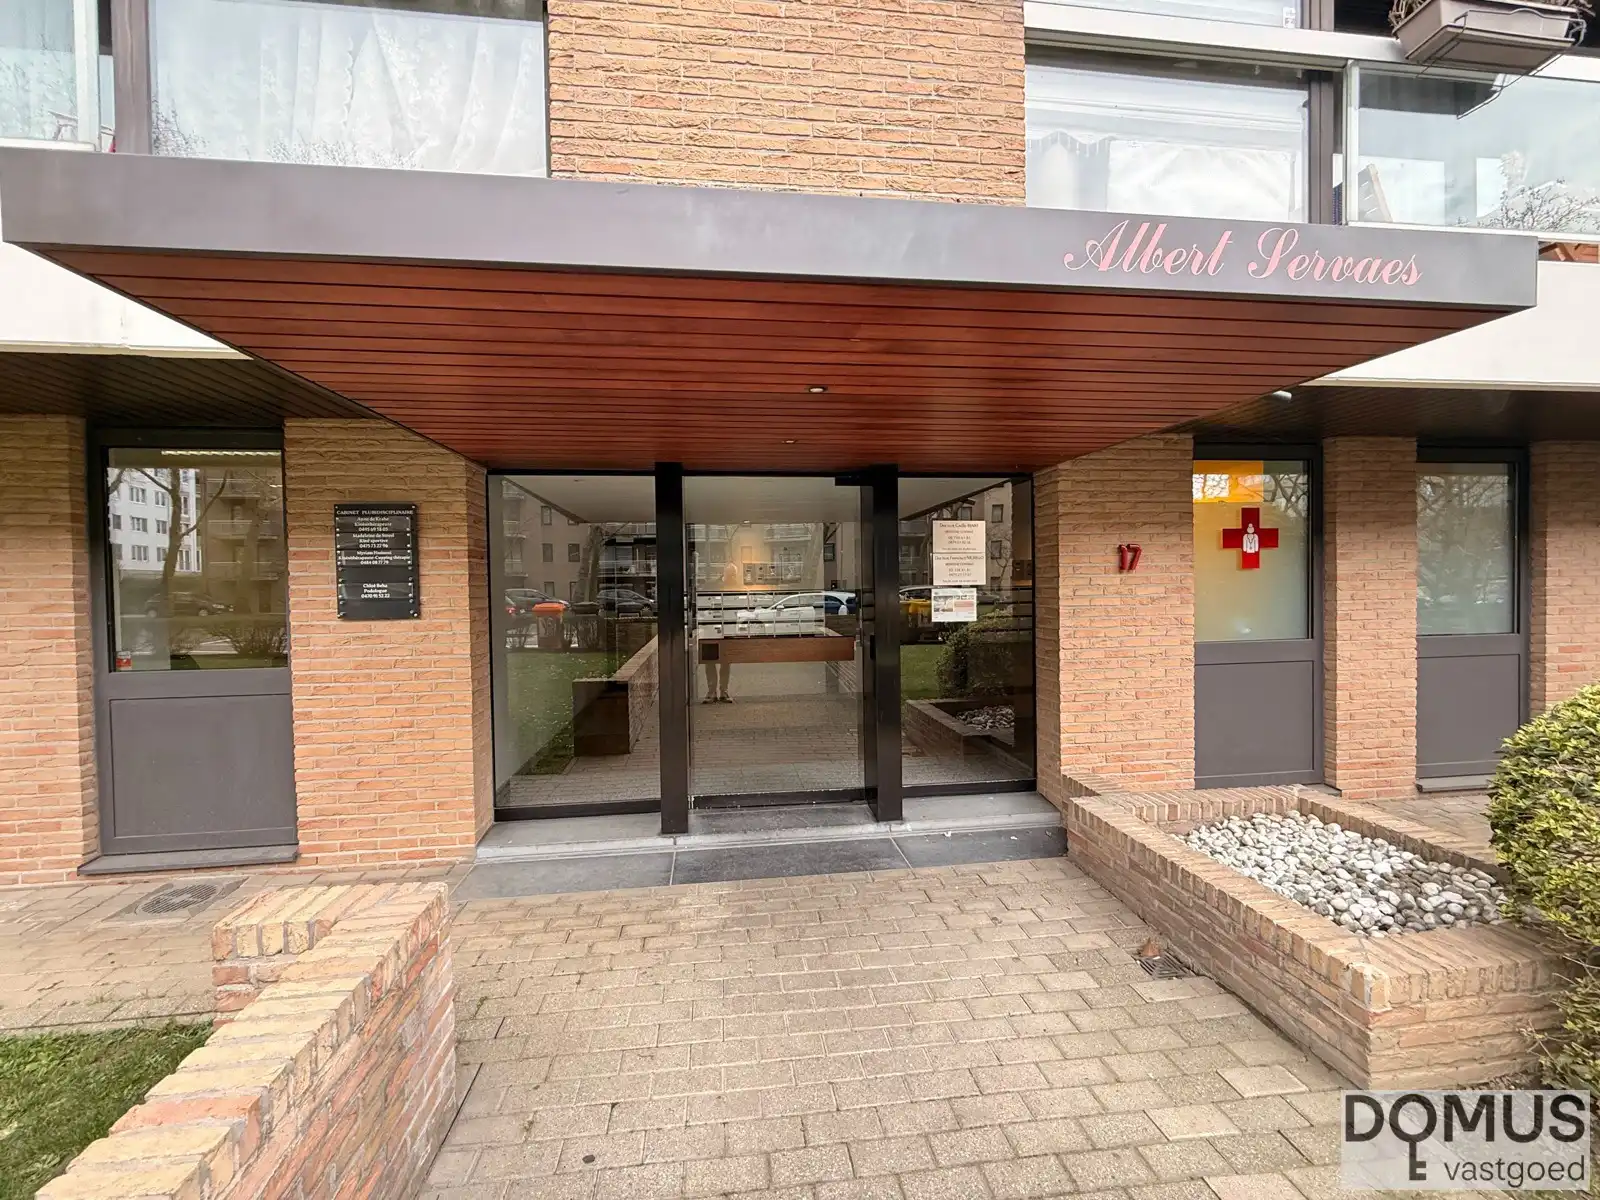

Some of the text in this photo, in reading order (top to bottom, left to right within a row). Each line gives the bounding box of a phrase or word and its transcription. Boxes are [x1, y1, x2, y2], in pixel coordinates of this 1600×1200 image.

[1063, 219, 1423, 286] Albert Servaes
[1117, 543, 1142, 573] 17
